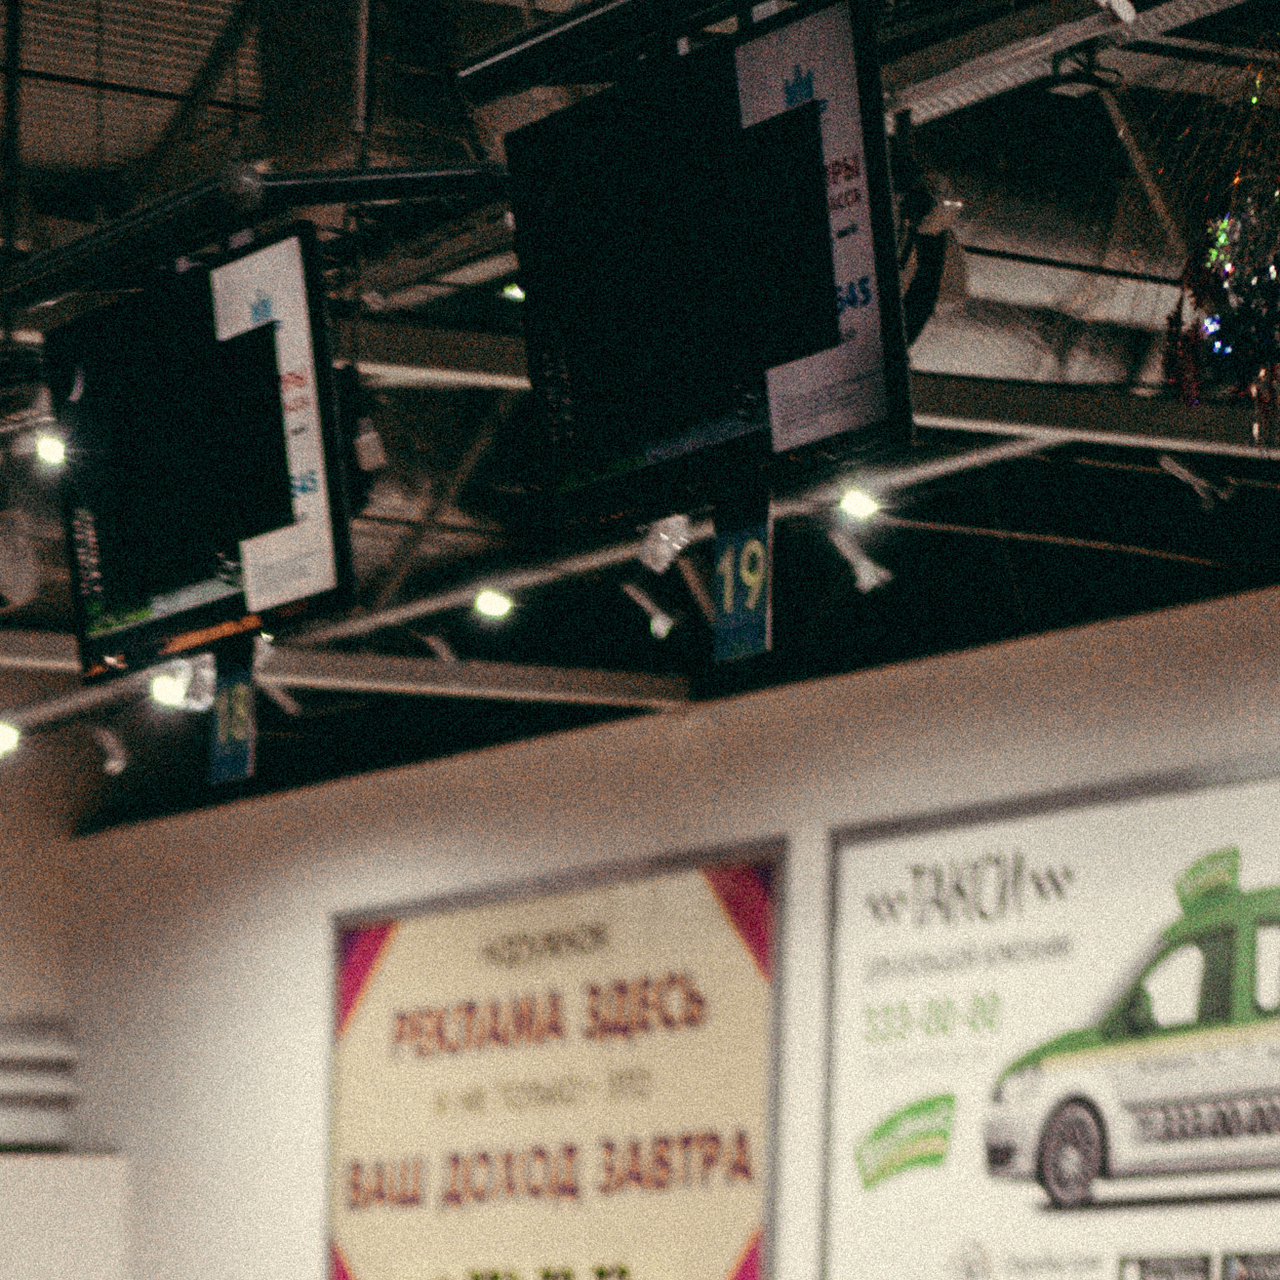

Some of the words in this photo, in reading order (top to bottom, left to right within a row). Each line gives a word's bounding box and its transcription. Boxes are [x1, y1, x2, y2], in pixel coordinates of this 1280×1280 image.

[716, 538, 767, 614] 19
[393, 987, 567, 1060] РЕКЛАМА
[584, 969, 708, 1041] ЗДЕСЬ
[346, 1157, 424, 1210] ВАШ
[442, 1142, 581, 1213] ДОХОД
[599, 1128, 755, 1194] ЗАВТРА
